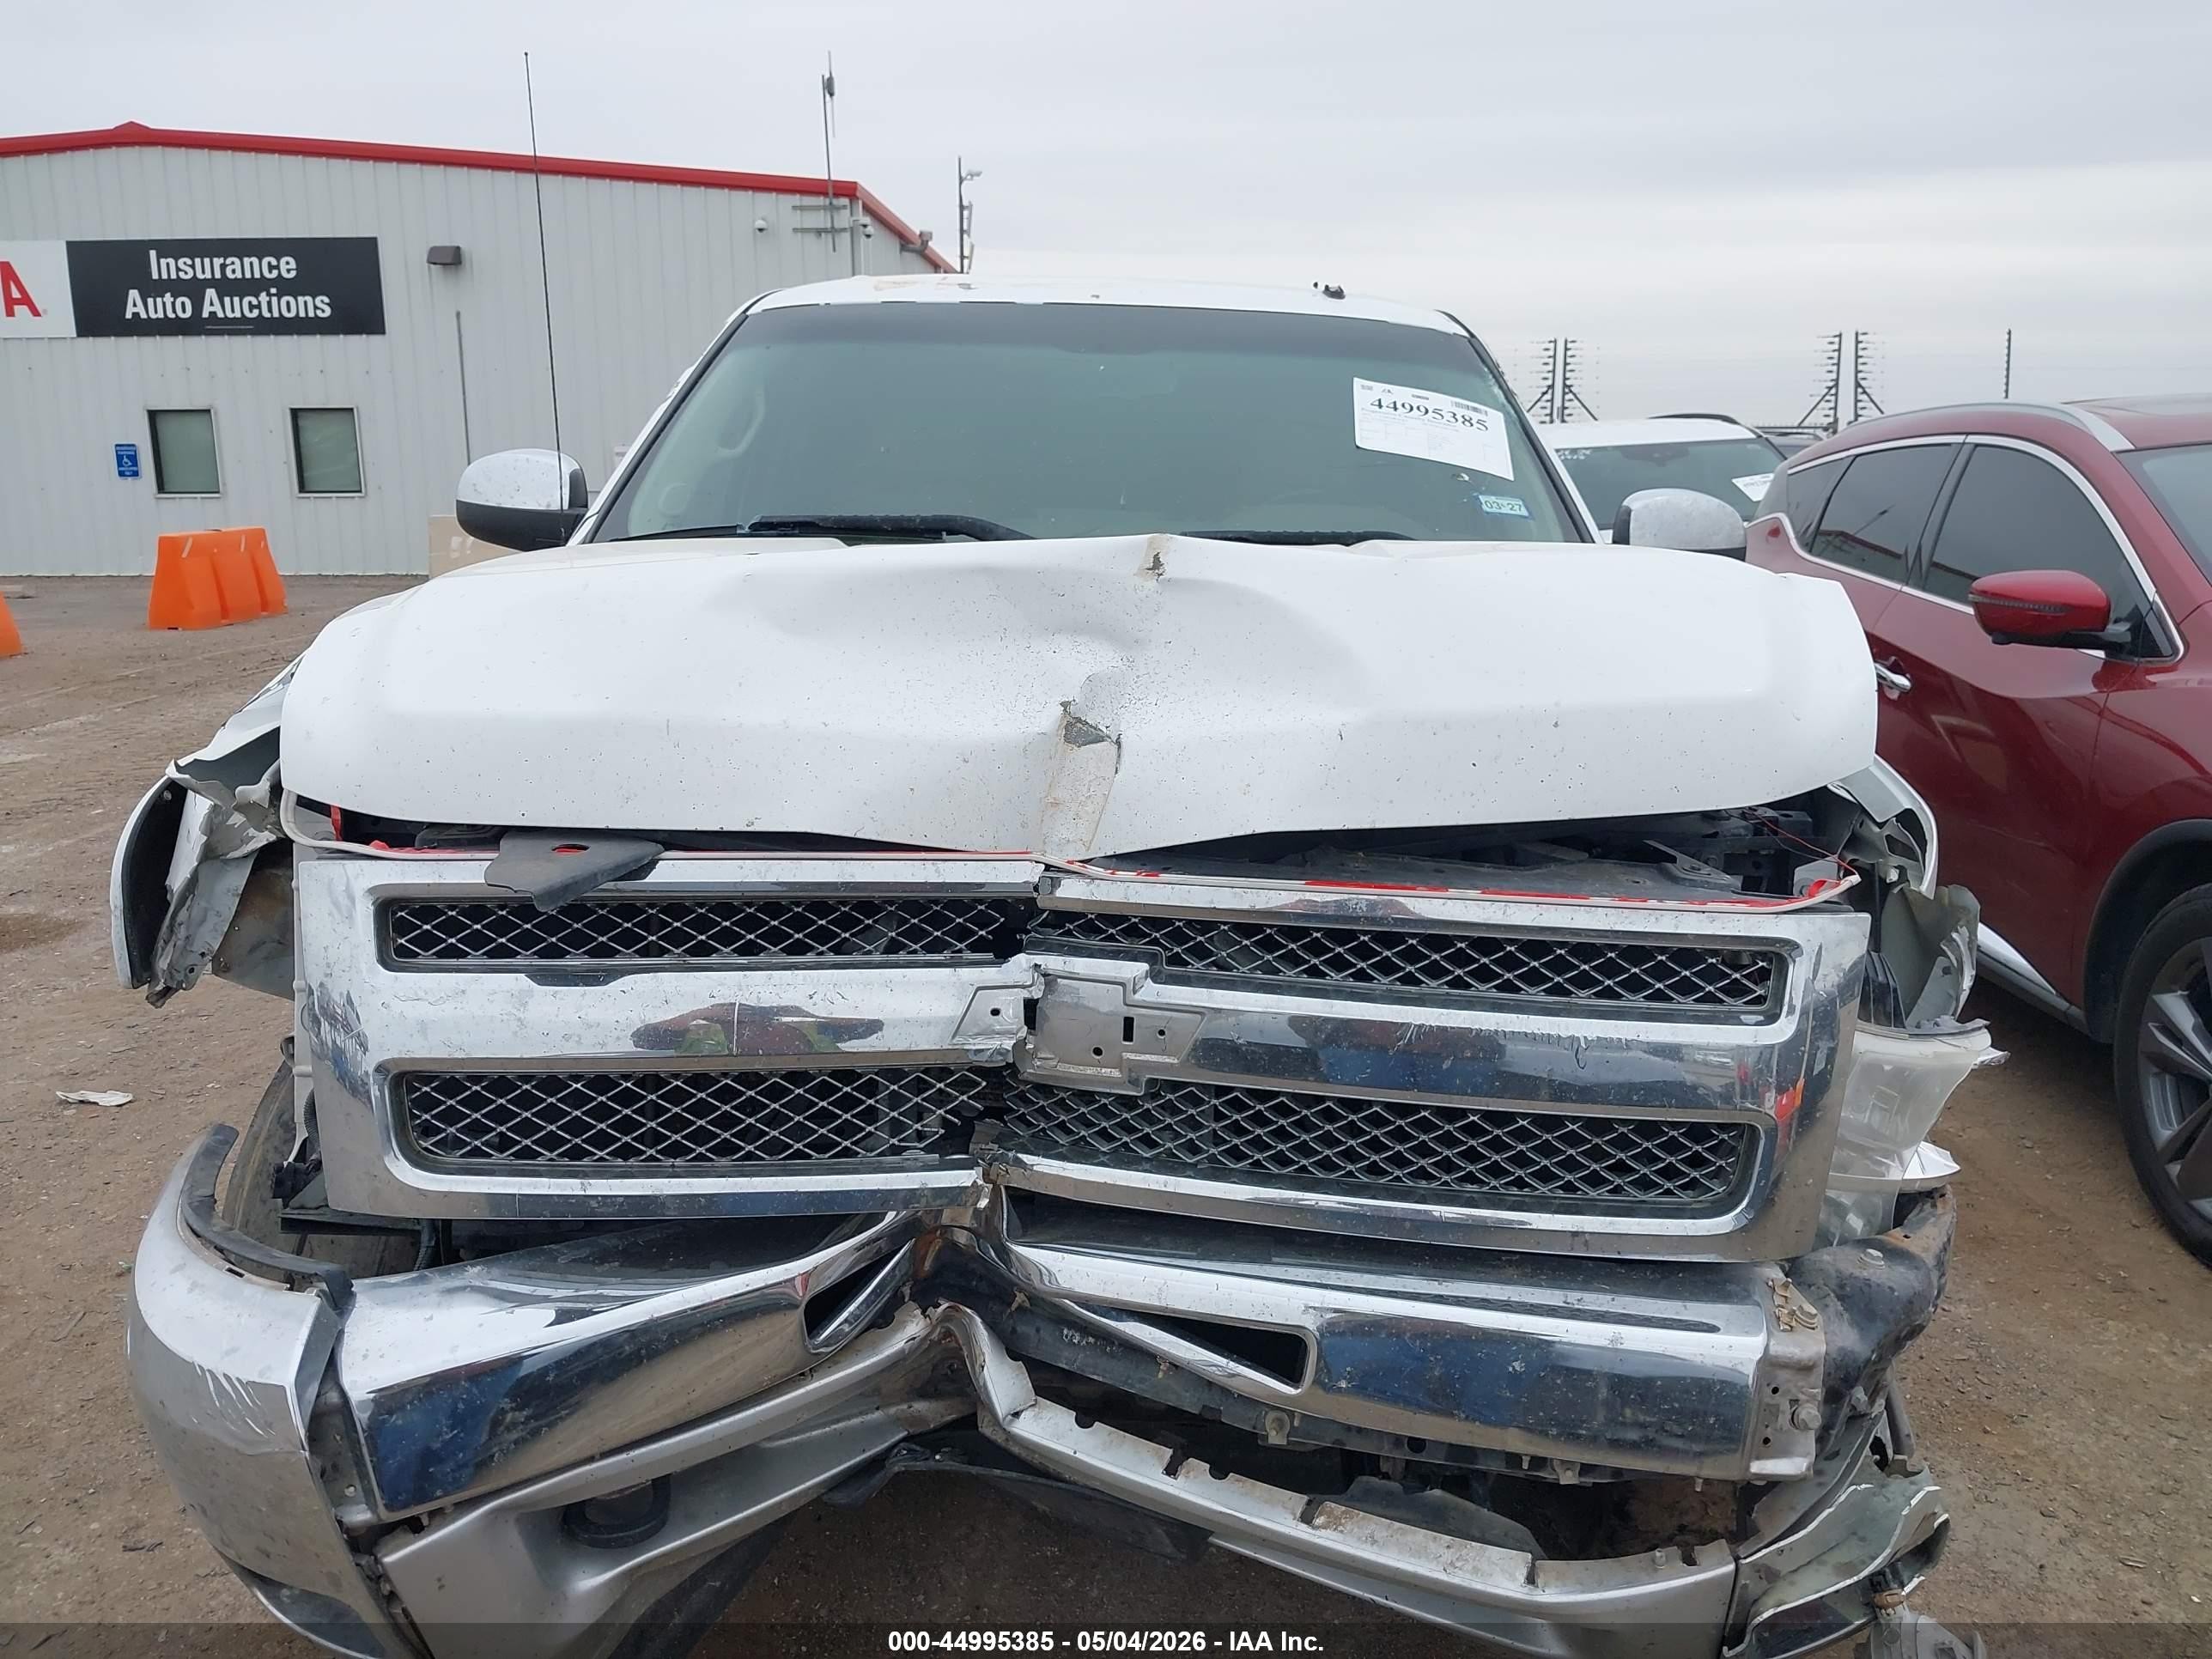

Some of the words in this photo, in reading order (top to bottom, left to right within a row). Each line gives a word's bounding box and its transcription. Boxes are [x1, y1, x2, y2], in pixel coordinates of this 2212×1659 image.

[149, 250, 298, 280] Insurance
[125, 289, 192, 319] Auto
[202, 288, 332, 319] Auctions
[1370, 398, 1489, 432] 44995385
